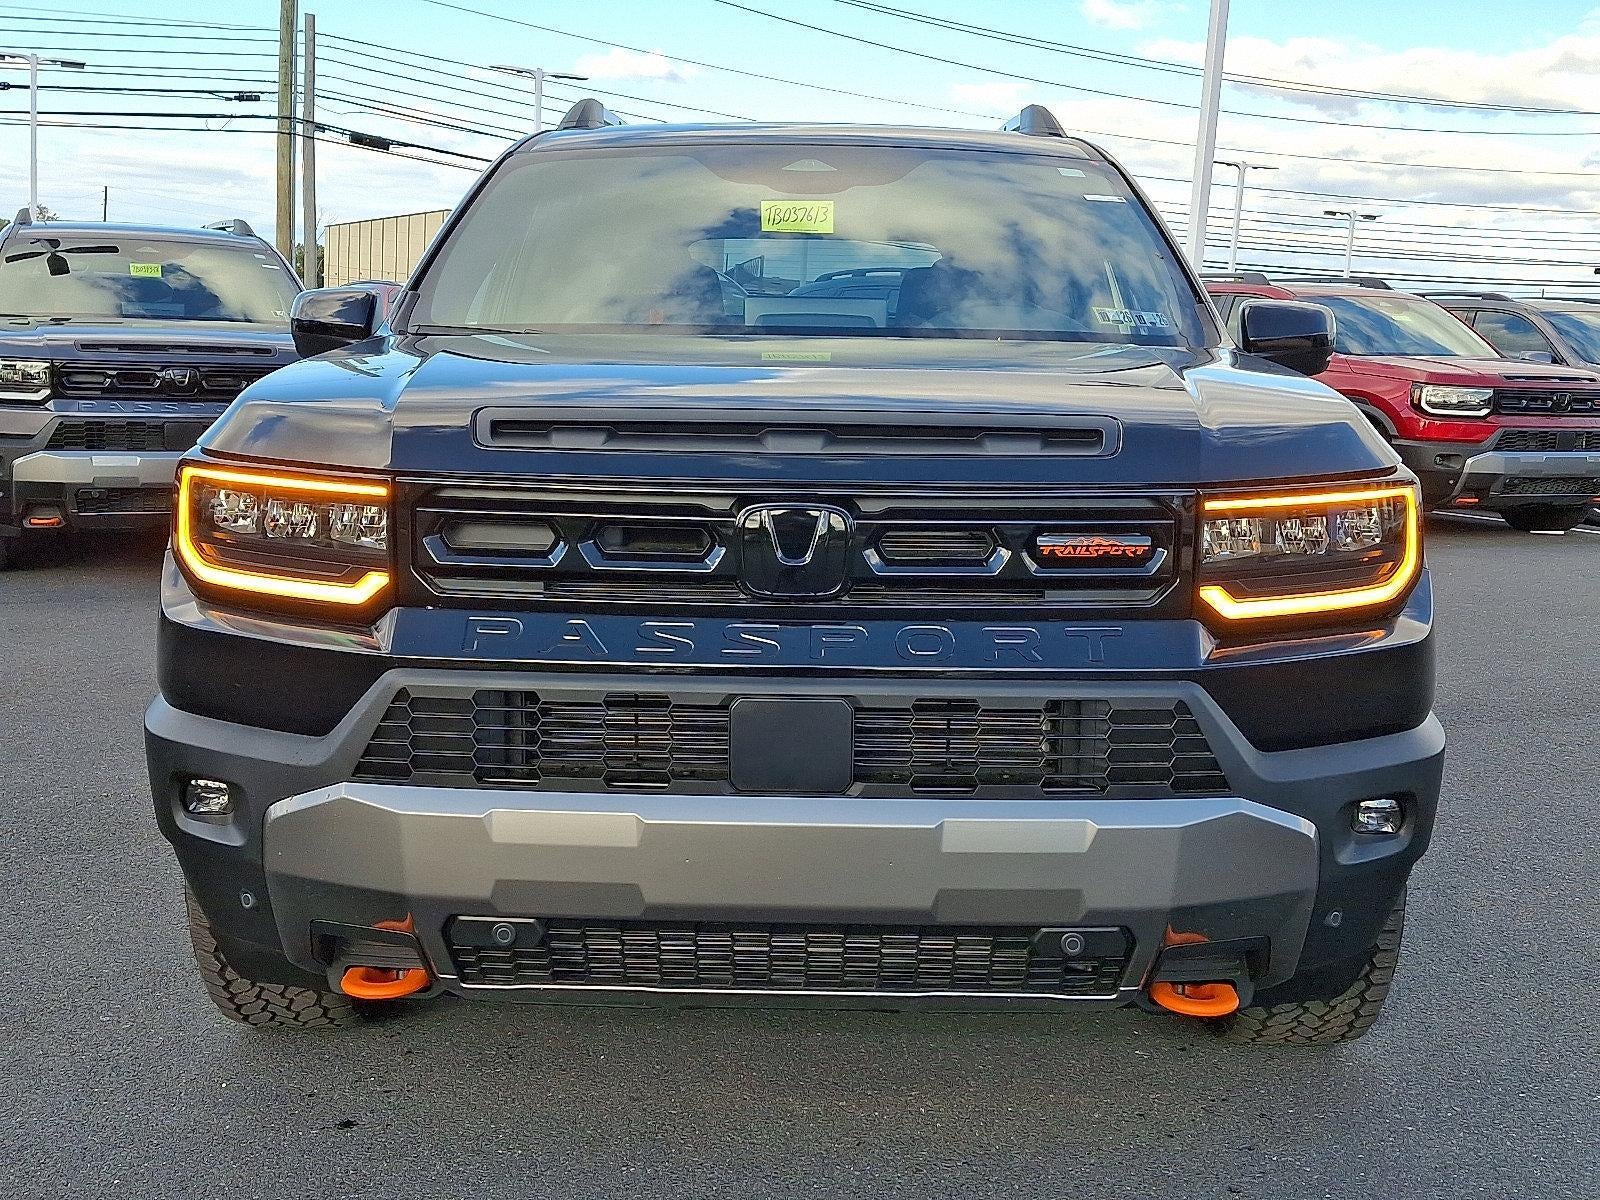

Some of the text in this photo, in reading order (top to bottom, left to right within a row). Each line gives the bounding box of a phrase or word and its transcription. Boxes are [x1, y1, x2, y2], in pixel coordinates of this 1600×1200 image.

[765, 204, 829, 226] TB037613
[1040, 546, 1149, 557] TRAILSPORT
[461, 616, 1124, 663] PASSPORT
